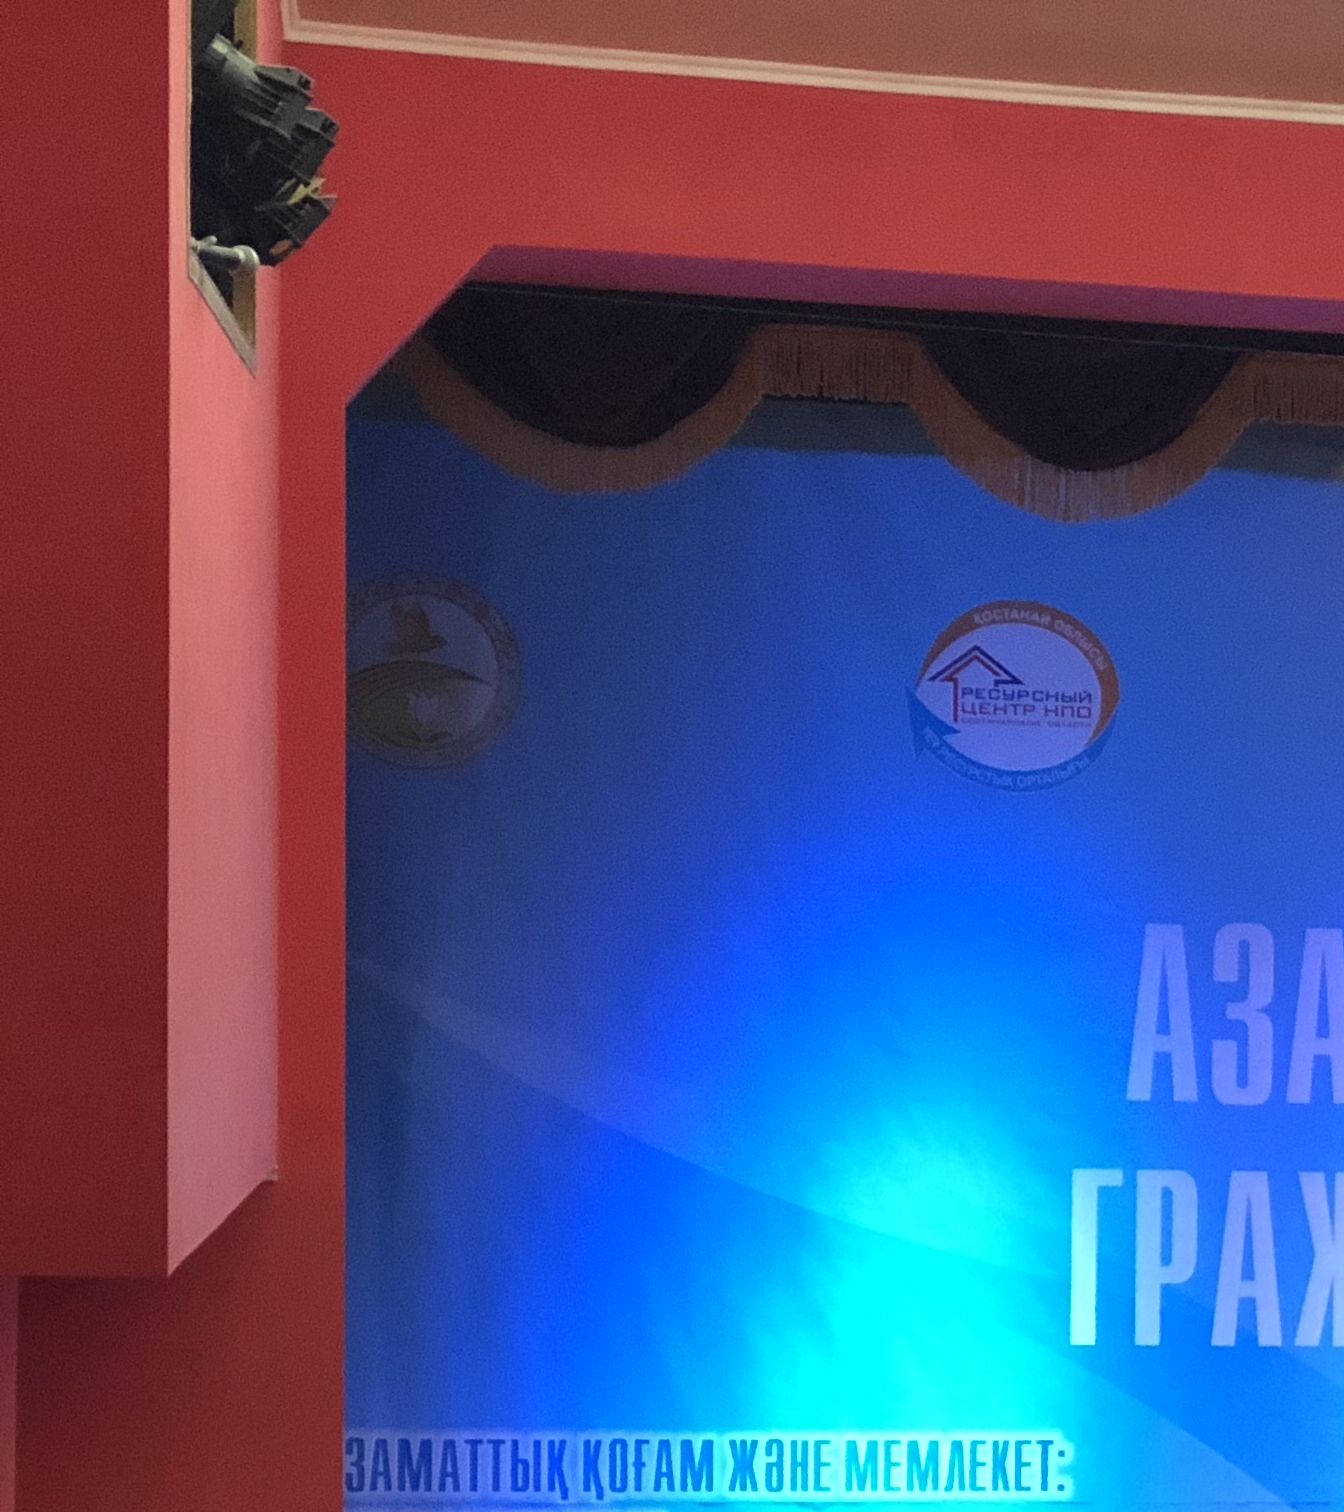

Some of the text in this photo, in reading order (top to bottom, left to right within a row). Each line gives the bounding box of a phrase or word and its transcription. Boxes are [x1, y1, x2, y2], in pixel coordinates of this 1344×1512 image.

[961, 687, 1092, 704] РЕСУРСНЫЙ
[961, 702, 1092, 719] ЦЕНТР НПО
[582, 1437, 715, 1500] ҚОҒАМ
[728, 1438, 832, 1493] ЖӘНЕ
[844, 1438, 1067, 1493] МЕМЛЕКЕТ:
